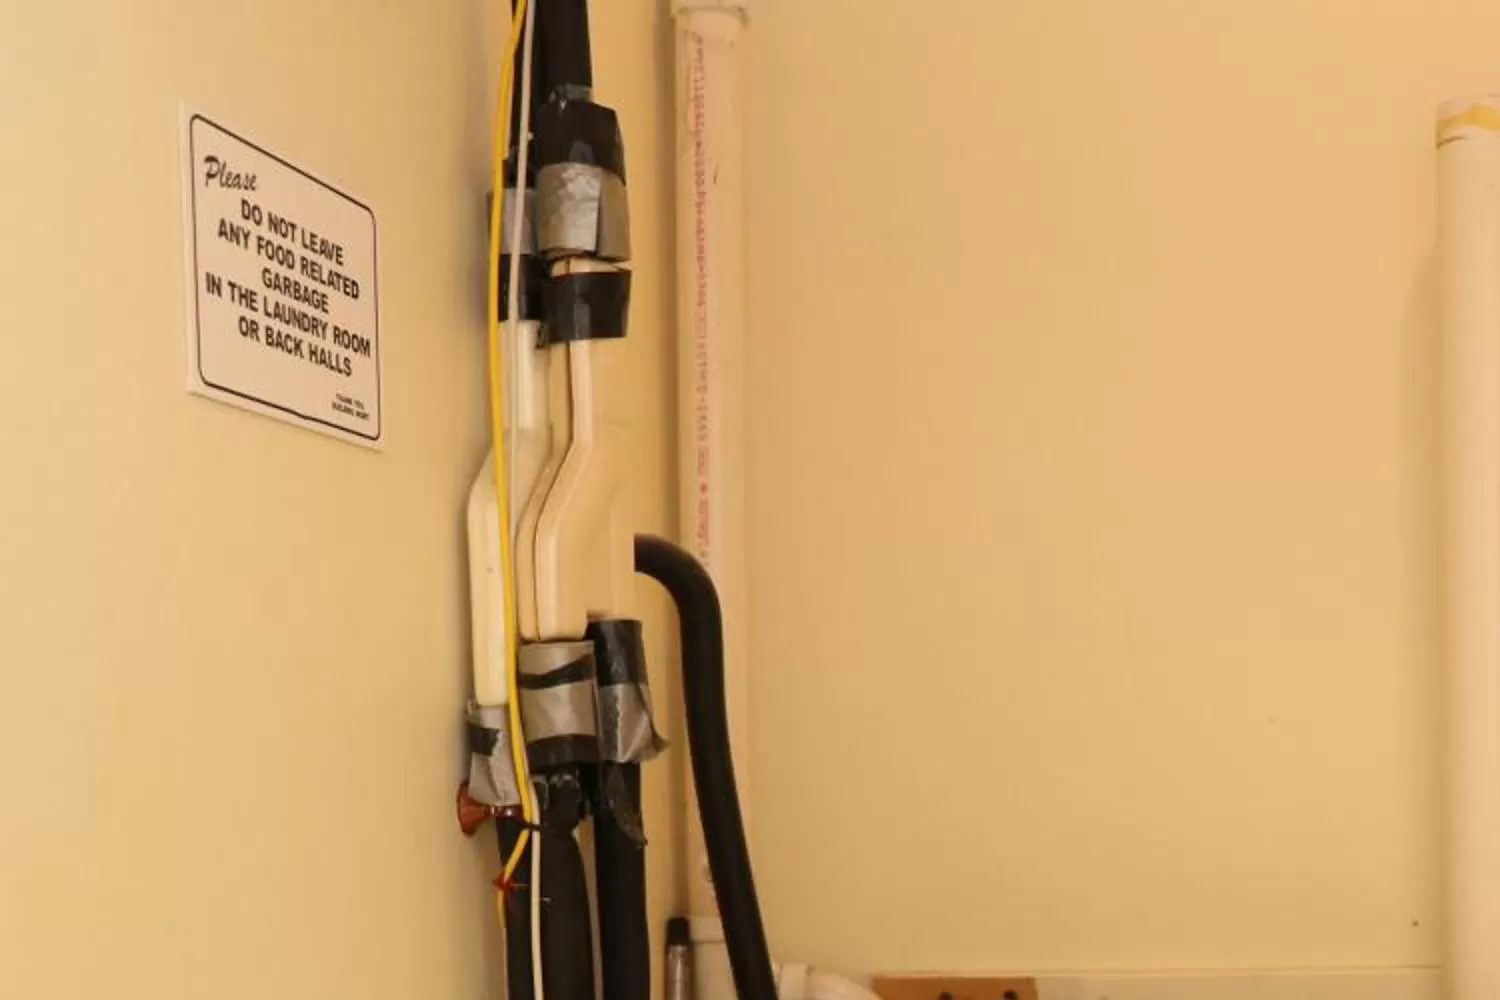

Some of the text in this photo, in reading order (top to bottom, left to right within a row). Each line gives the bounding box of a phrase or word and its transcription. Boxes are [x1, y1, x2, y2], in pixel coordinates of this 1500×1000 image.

[204, 155, 257, 191] Please
[218, 218, 360, 300] ANY FOOD RELATED
[240, 198, 344, 266] DO NOT LEAVE
[205, 271, 372, 358] IN THE LAUNDRY ROOM
[261, 267, 329, 315] GARBAGE
[238, 315, 353, 377] OR BACK HALLS
